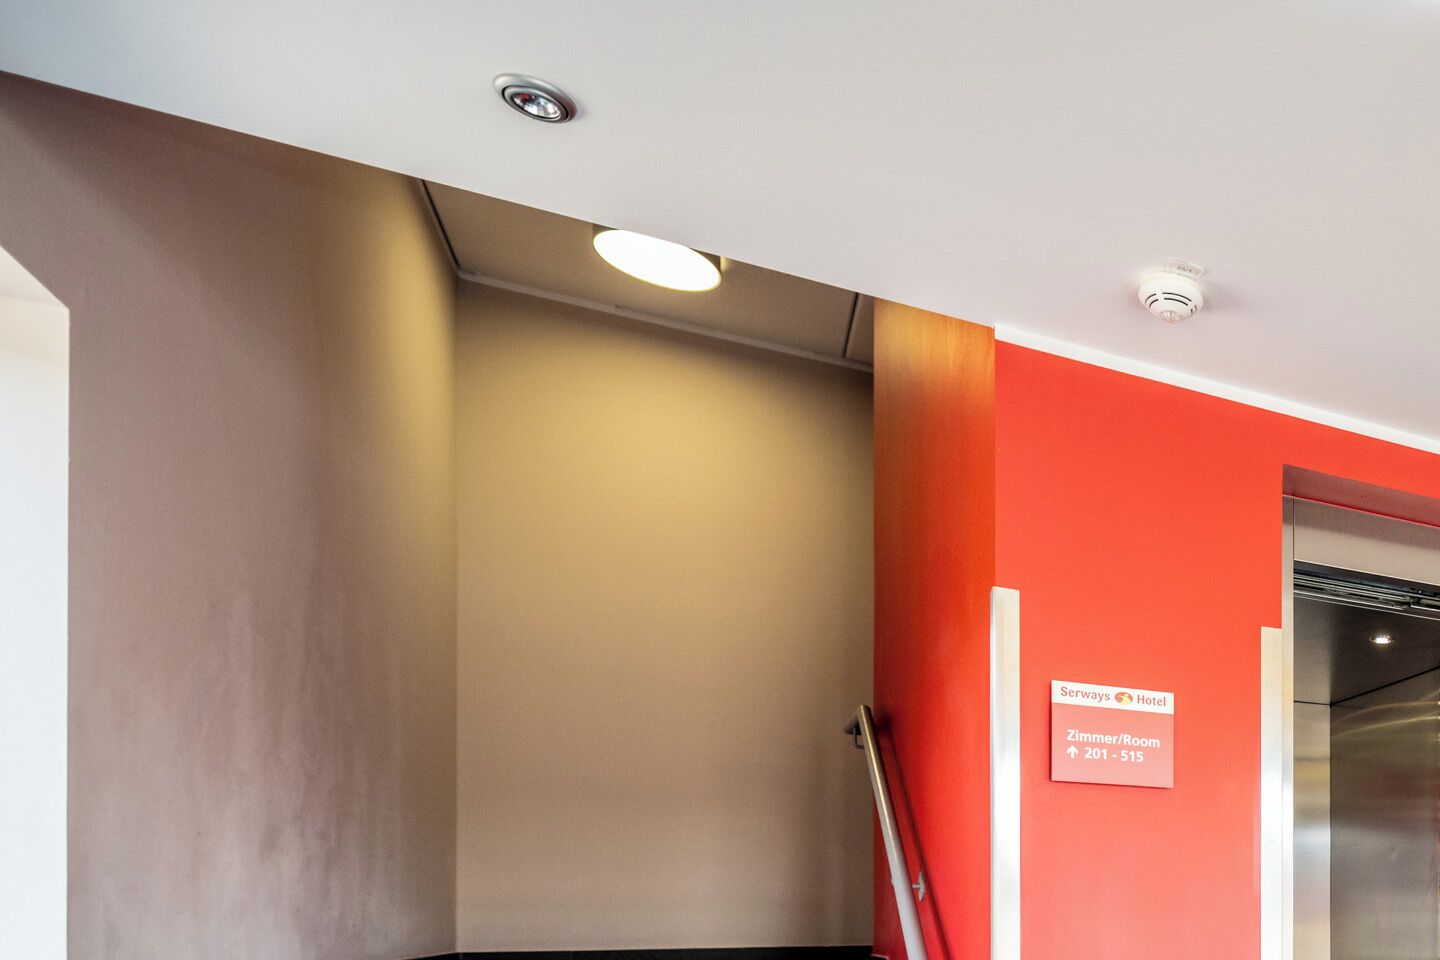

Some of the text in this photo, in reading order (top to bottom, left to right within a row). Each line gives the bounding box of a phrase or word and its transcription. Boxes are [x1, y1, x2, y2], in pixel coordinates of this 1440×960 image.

[1060, 686, 1167, 707] Serways Hotel
[1066, 729, 1161, 748] Zimmer/Room
[1084, 747, 1107, 760] 201
[1120, 749, 1144, 763] 515
